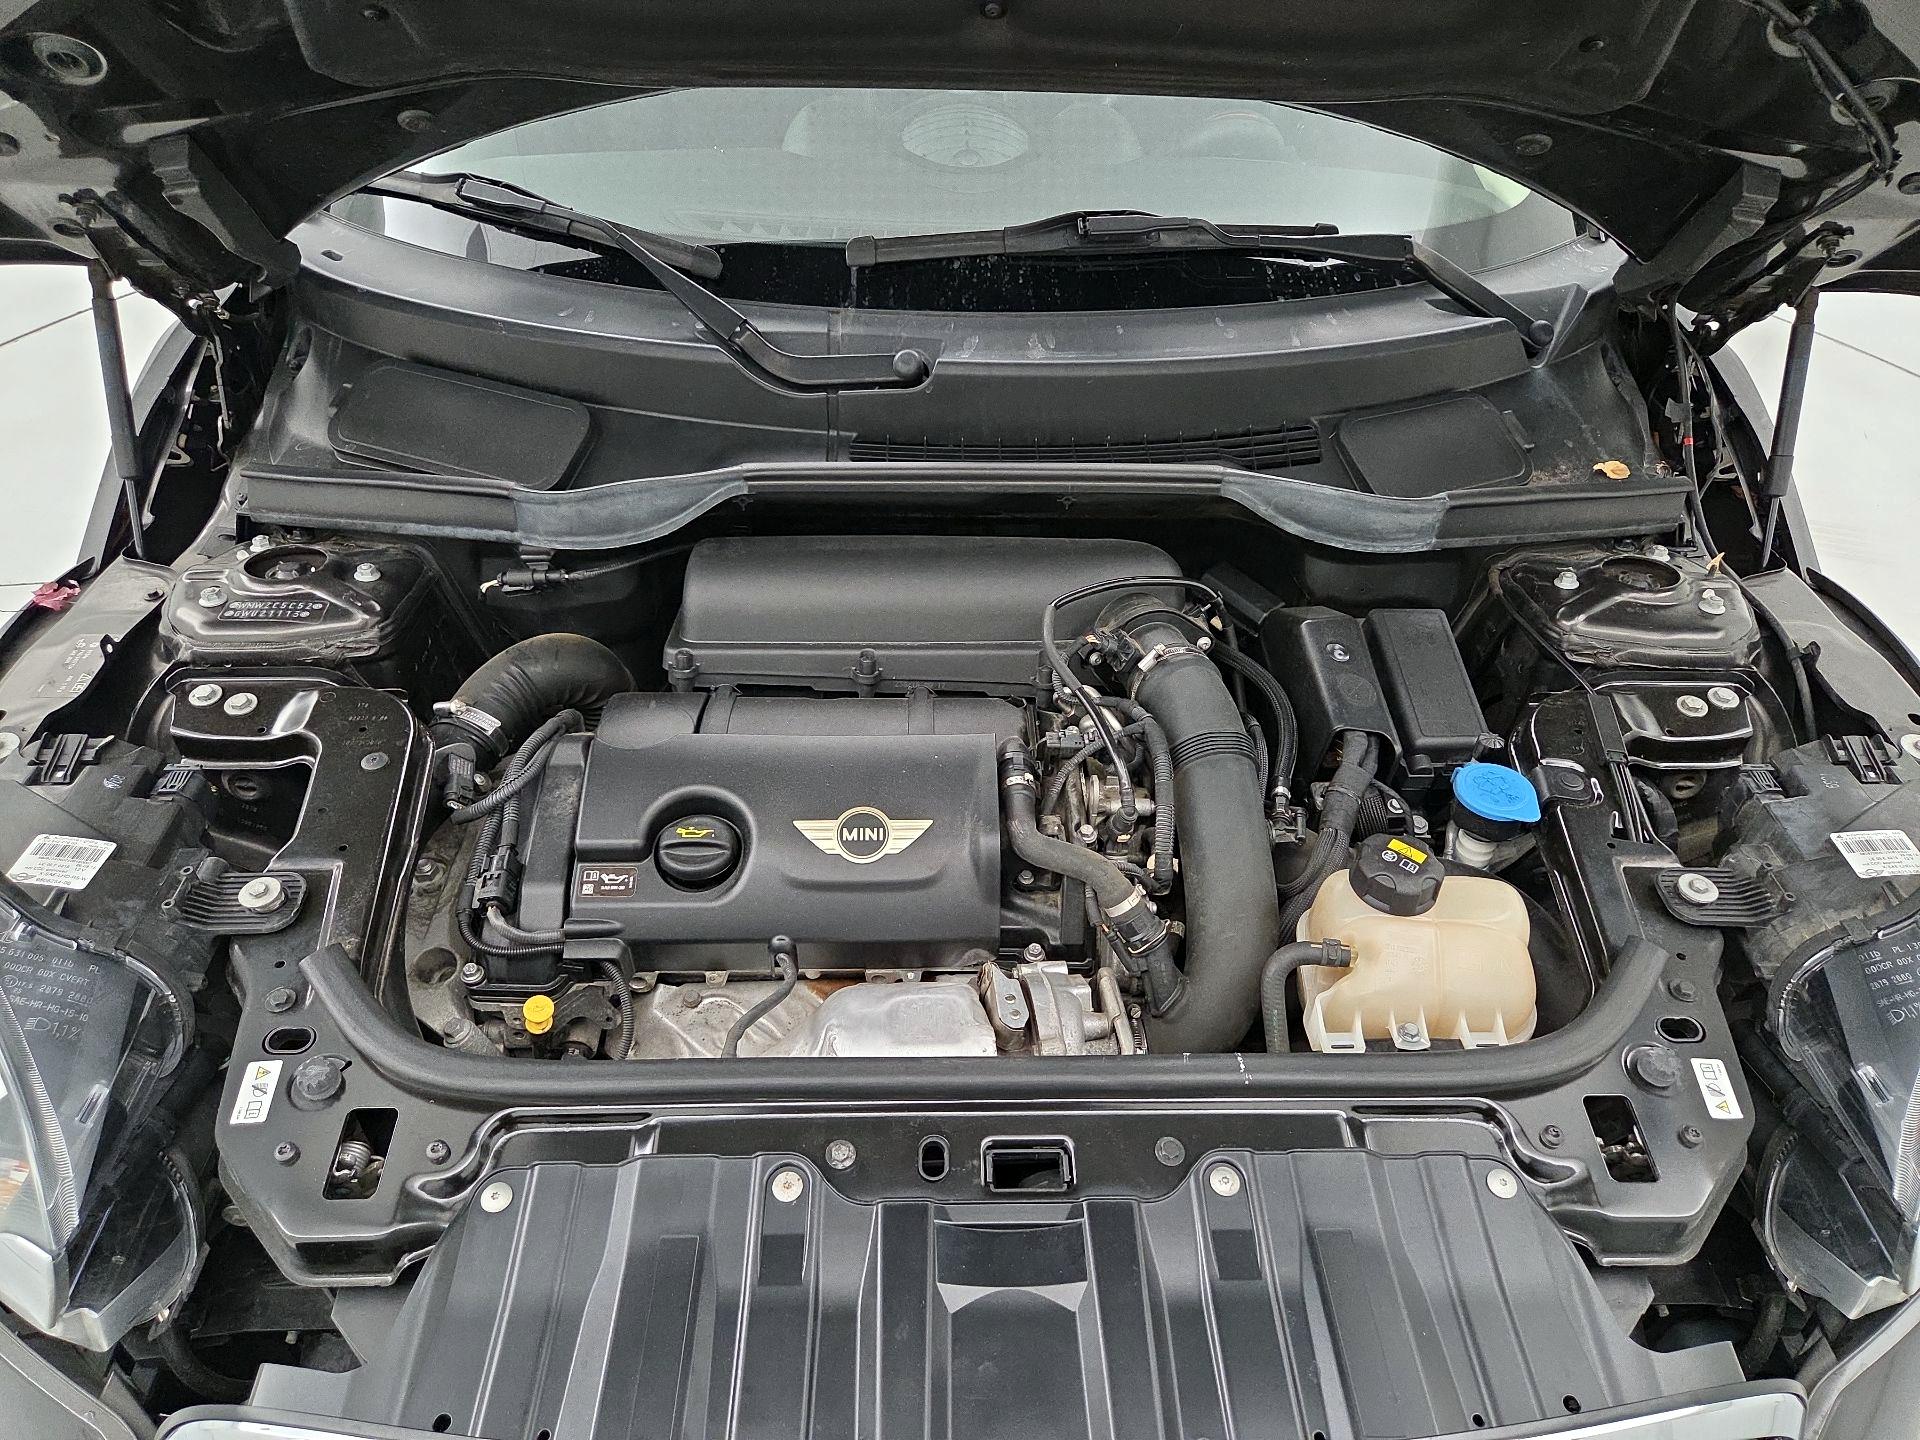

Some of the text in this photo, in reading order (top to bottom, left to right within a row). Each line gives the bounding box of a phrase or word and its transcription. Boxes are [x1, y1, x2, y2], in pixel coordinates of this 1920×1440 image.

[842, 827, 884, 841] MINI
[1891, 945, 1904, 954] PL
[88, 964, 101, 975] PL
